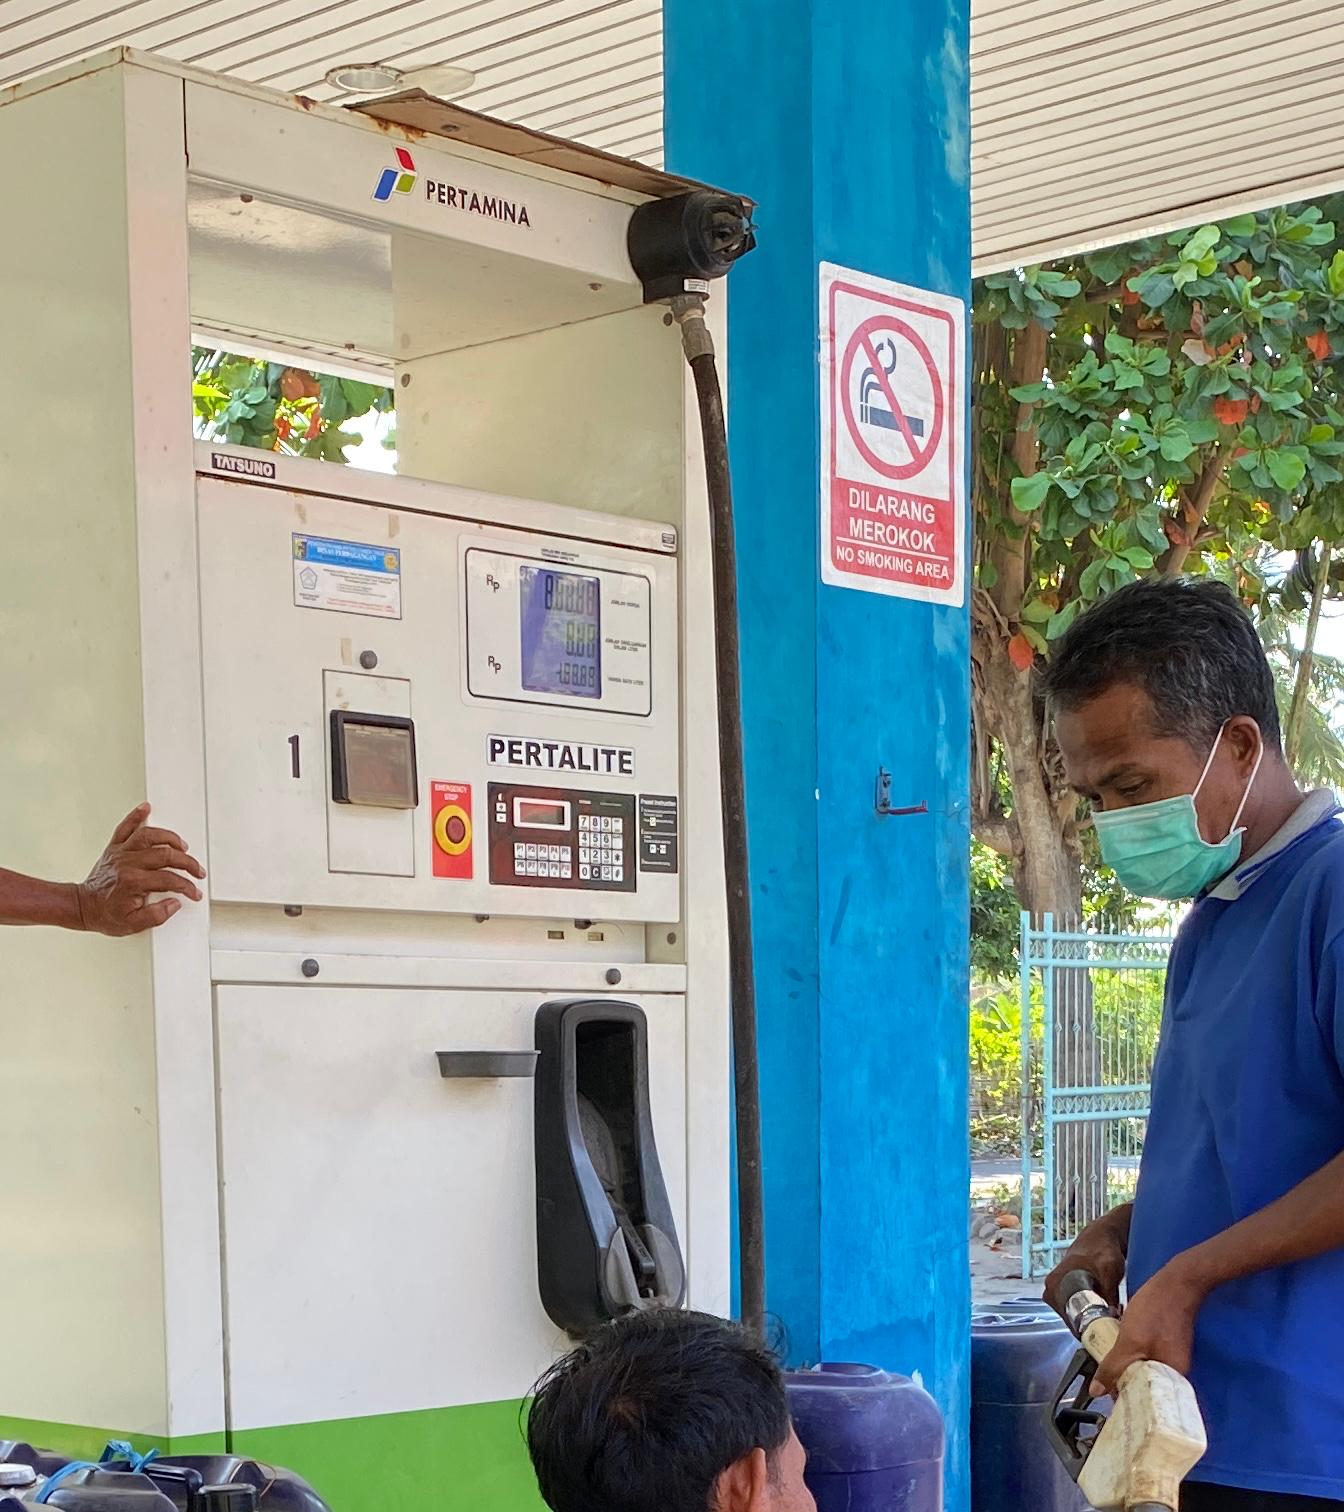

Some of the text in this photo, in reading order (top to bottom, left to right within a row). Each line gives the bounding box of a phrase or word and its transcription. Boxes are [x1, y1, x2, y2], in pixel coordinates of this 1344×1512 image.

[427, 180, 530, 227] PERTAMINA
[214, 454, 273, 477] TATSUNO
[849, 487, 935, 524] DILARANG
[849, 517, 935, 552] MEROKOK
[836, 545, 950, 580] NO SMOKING AREA
[288, 735, 300, 778] 1
[490, 738, 632, 774] PERTALITE
